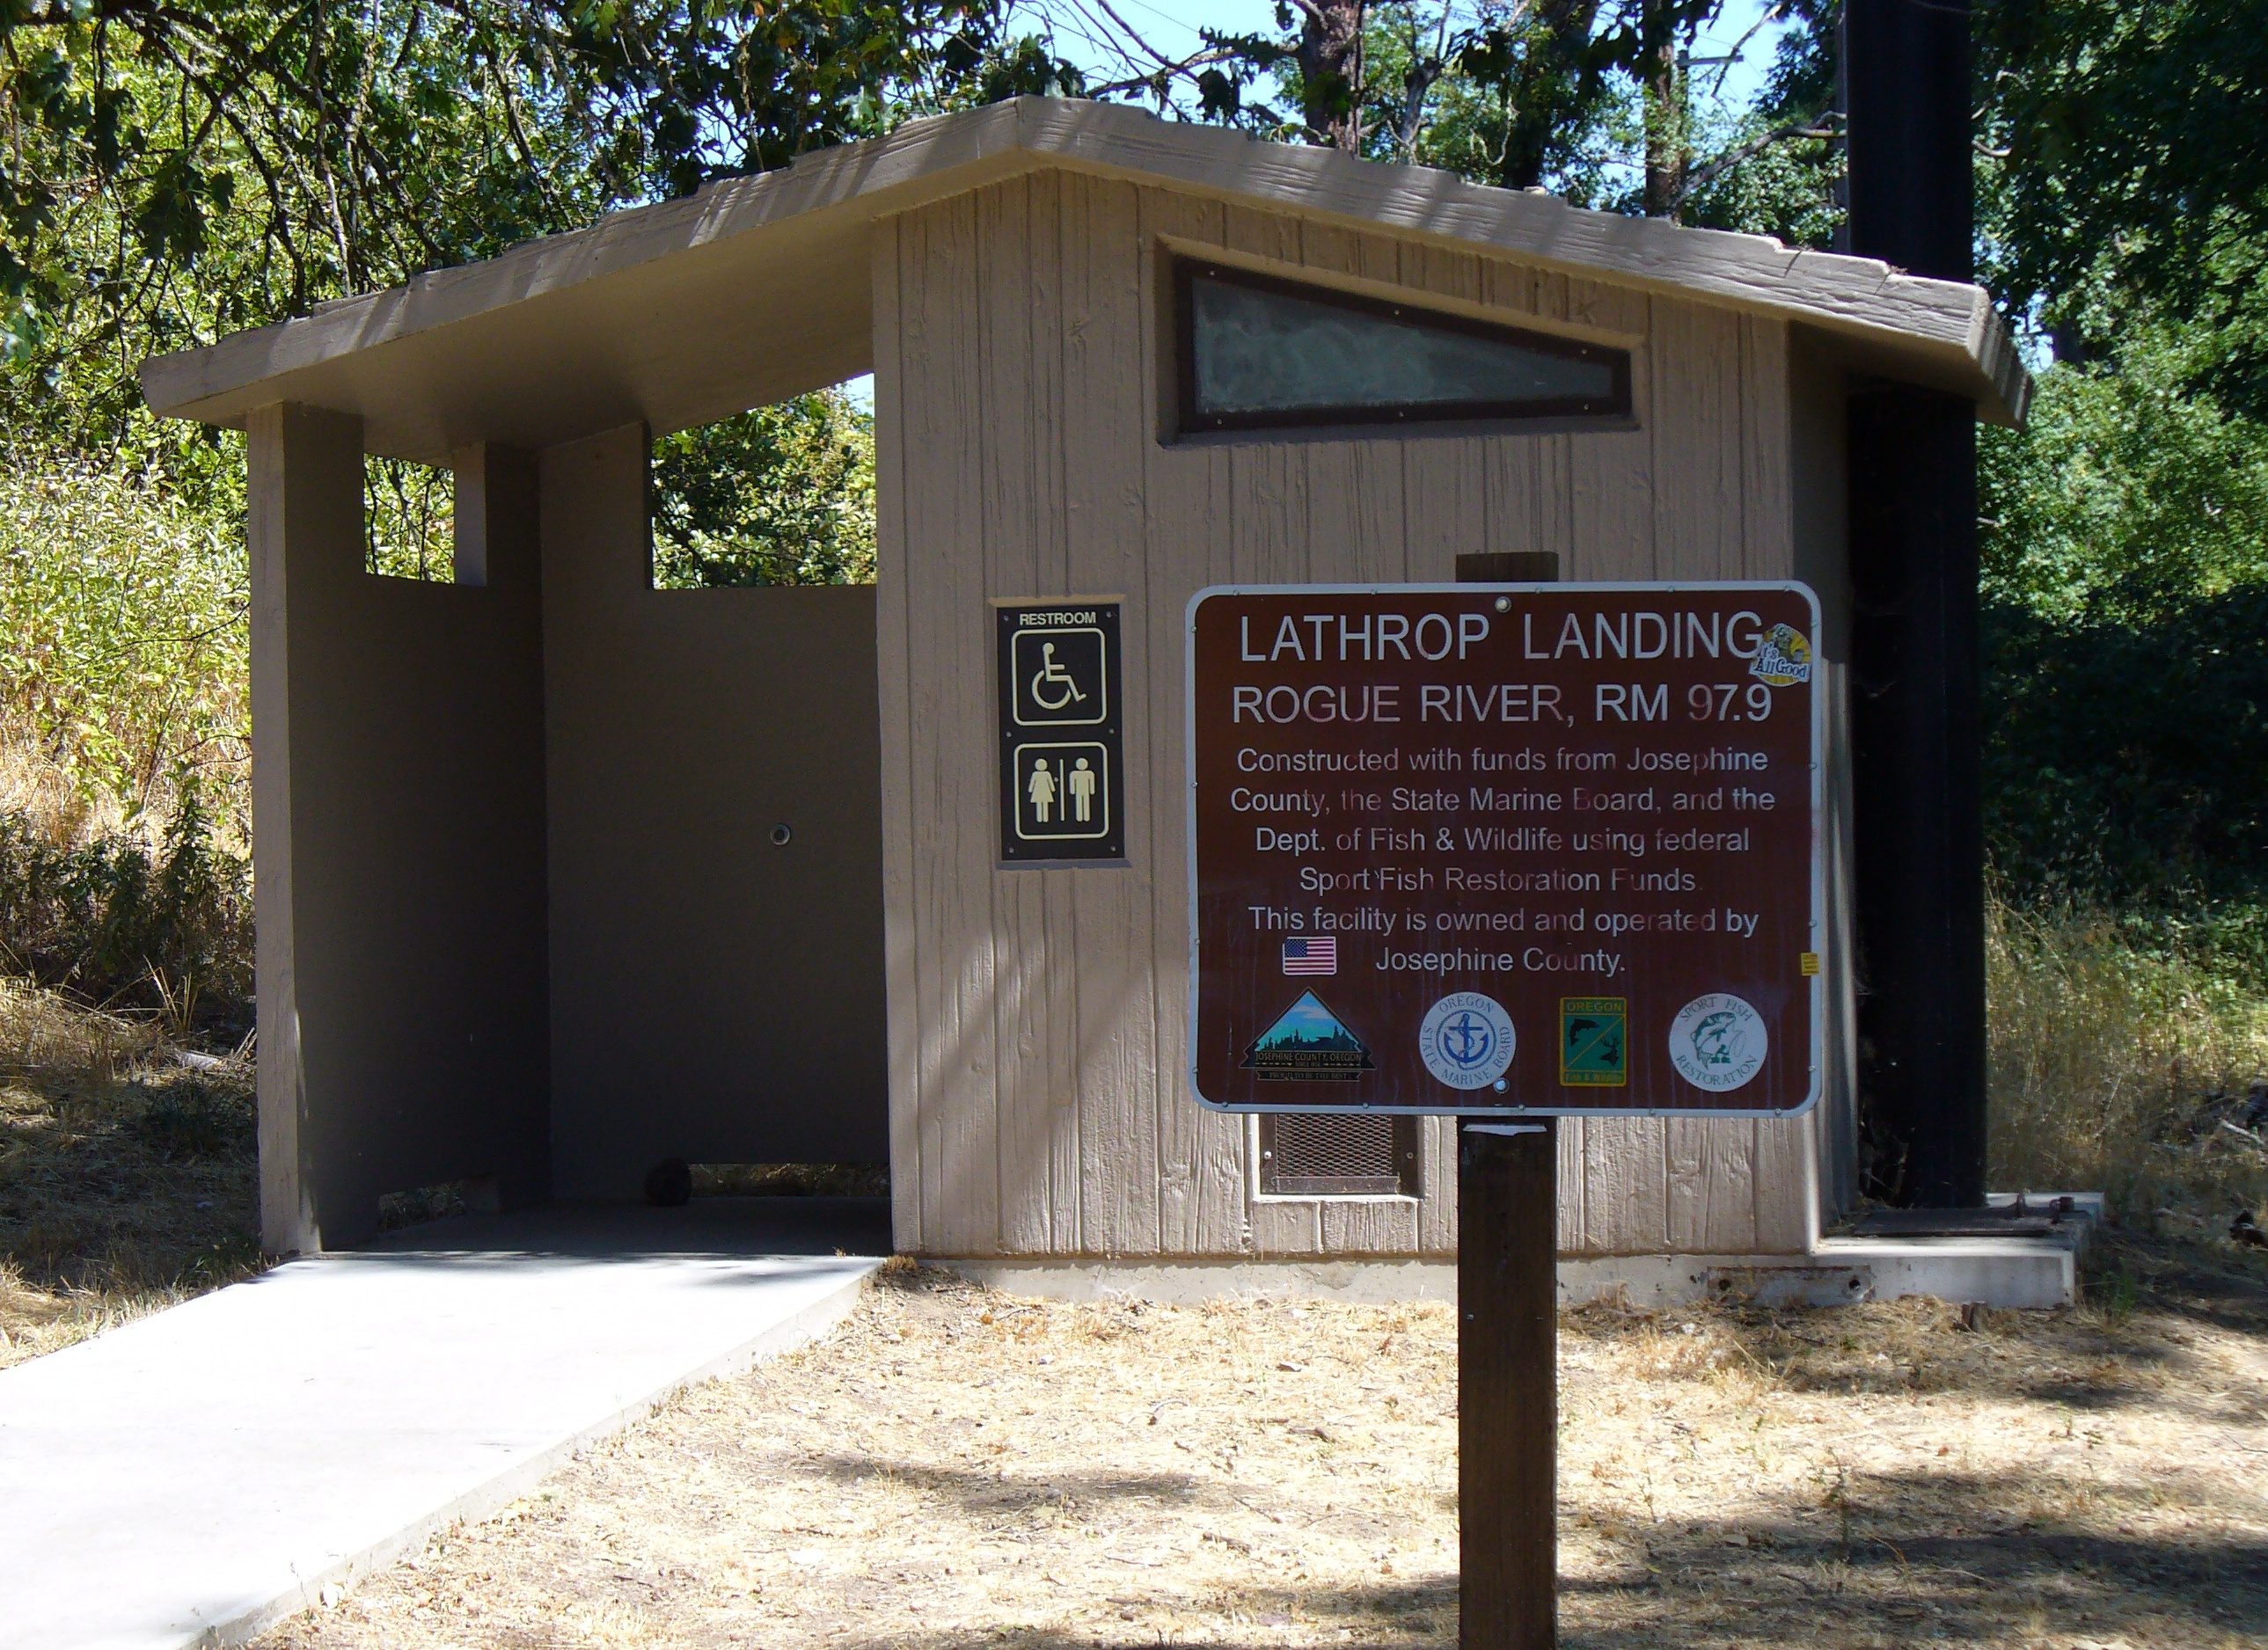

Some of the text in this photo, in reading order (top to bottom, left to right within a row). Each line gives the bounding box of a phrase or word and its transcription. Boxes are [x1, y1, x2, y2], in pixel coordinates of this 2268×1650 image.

[1019, 612, 1097, 626] RESTROOM
[1240, 610, 1763, 662] LATHROP LANDING
[1776, 659, 1807, 677] Good
[1233, 683, 1773, 728] ROGUE RIVER, RM 97.9
[1237, 747, 1768, 776] Constructed with funds from Josephine
[1231, 787, 1775, 816] County, the State Marine Board, and the
[1255, 828, 1750, 858] Dept. of Fish & Wildlife using federal
[1299, 868, 1371, 897] Sport
[1379, 868, 1435, 892] Fish
[1445, 867, 1601, 892] Restoration
[1248, 907, 1760, 938] This facility is owned and operated by
[1376, 946, 1627, 977] Josephine County.
[1438, 995, 1494, 1013] OREGON
[1567, 1002, 1622, 1012] OREGON
[1679, 997, 1753, 1021] SPORT FISH
[1255, 1052, 1293, 1061] JOSEPHINE
[1329, 1052, 1361, 1062] OREGON
[1422, 1025, 1511, 1085] STATE MARINE BOARD
[1676, 1054, 1758, 1086] RESTORATION
